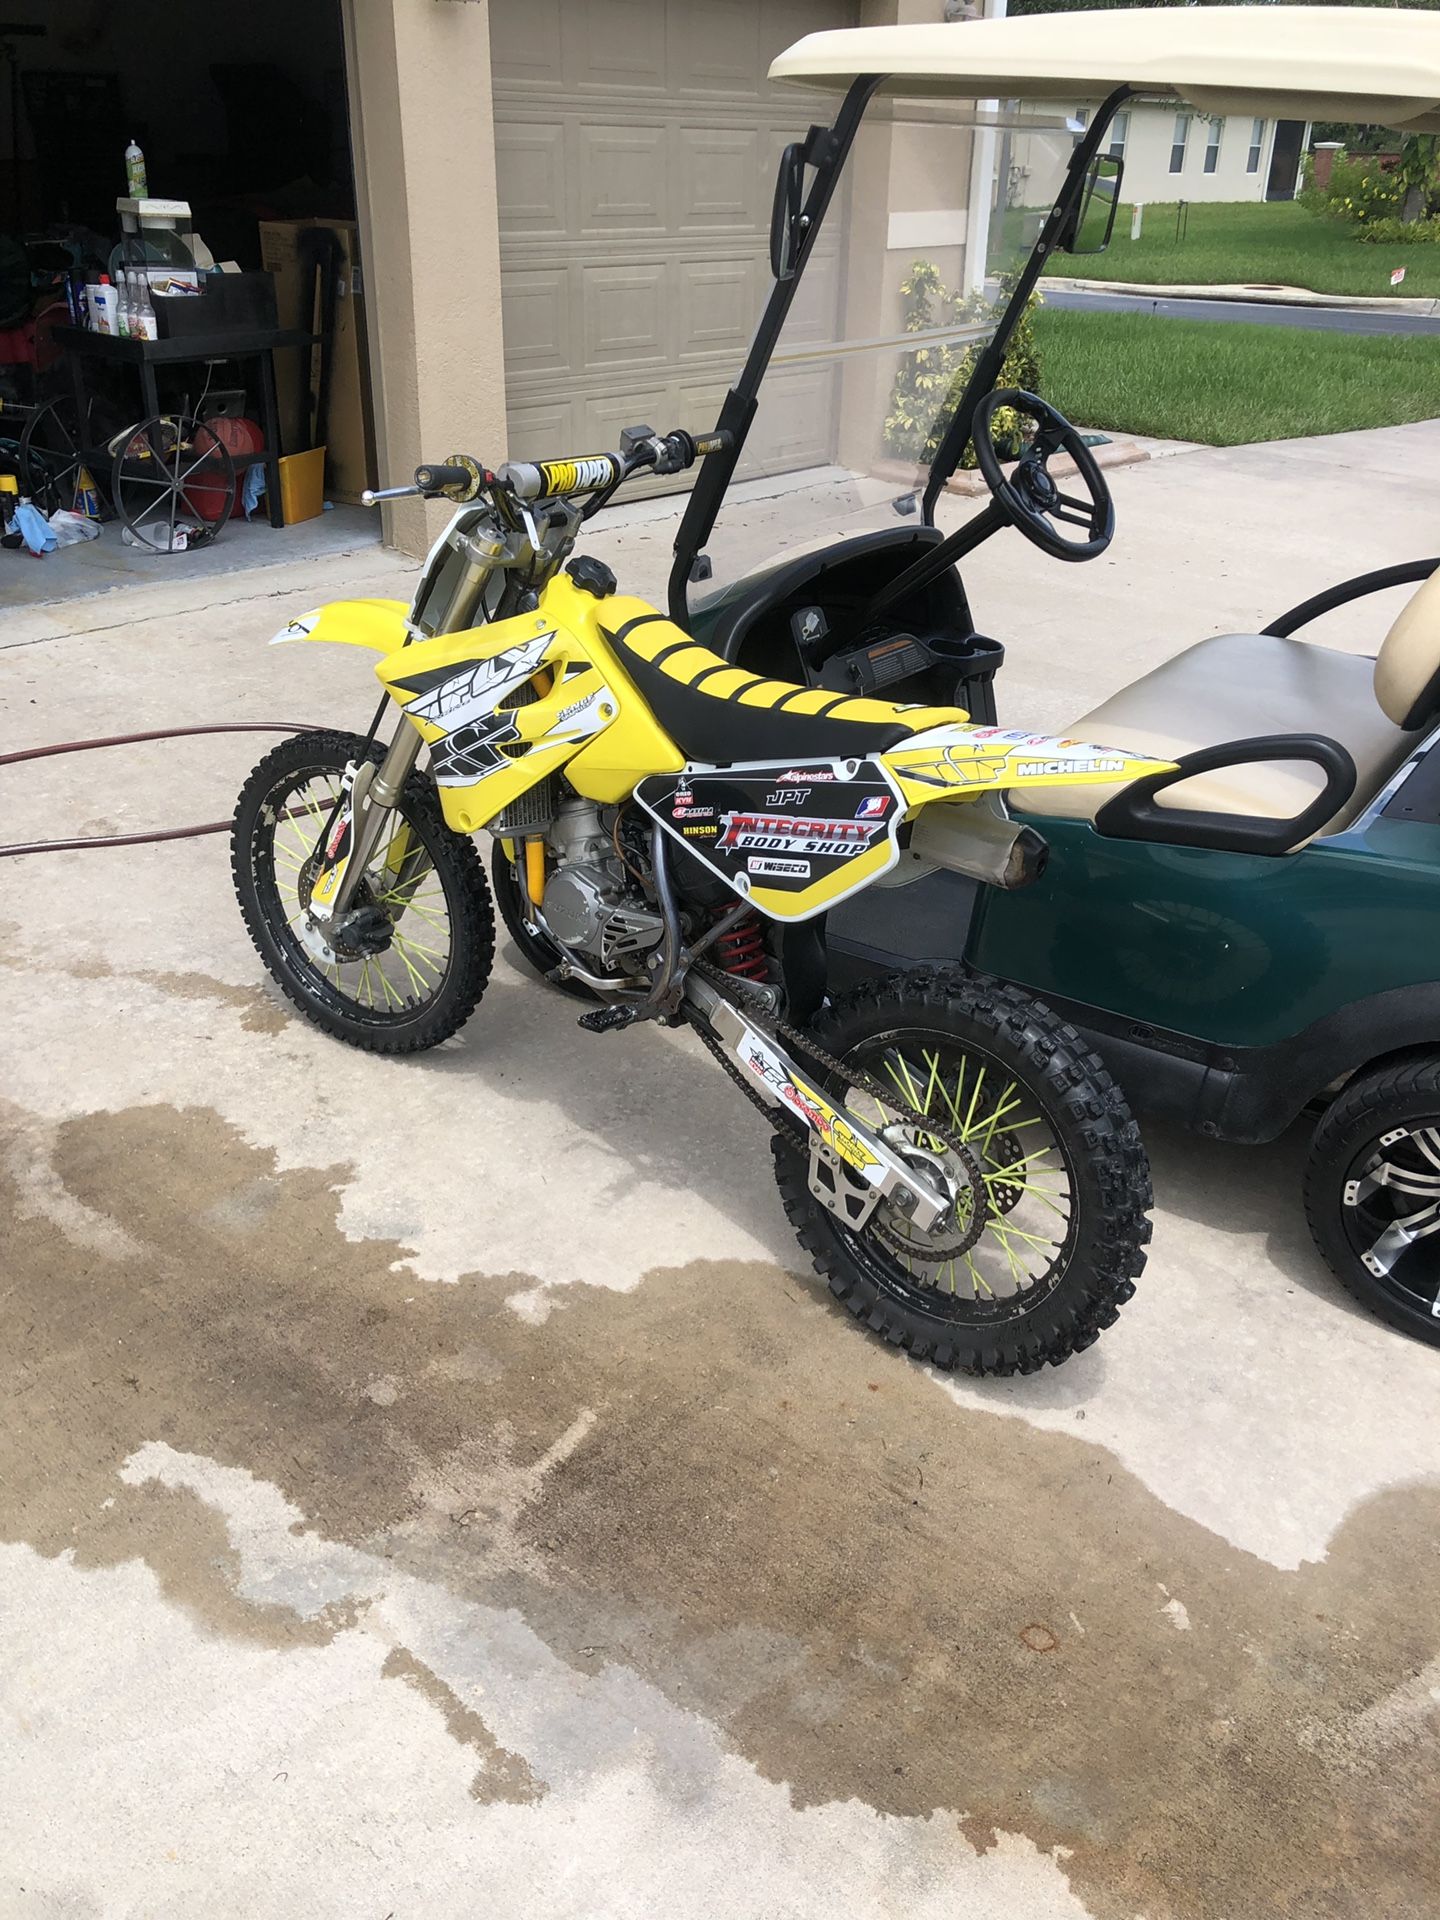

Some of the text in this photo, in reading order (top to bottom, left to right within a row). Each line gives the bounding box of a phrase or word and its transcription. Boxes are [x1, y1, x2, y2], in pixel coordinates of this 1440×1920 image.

[1016, 760, 1126, 776] MICHELIN
[765, 788, 811, 806] JPT
[683, 826, 718, 835] HINSON
[717, 815, 873, 847] INTEGRITY
[740, 836, 868, 855] BODY SHOP
